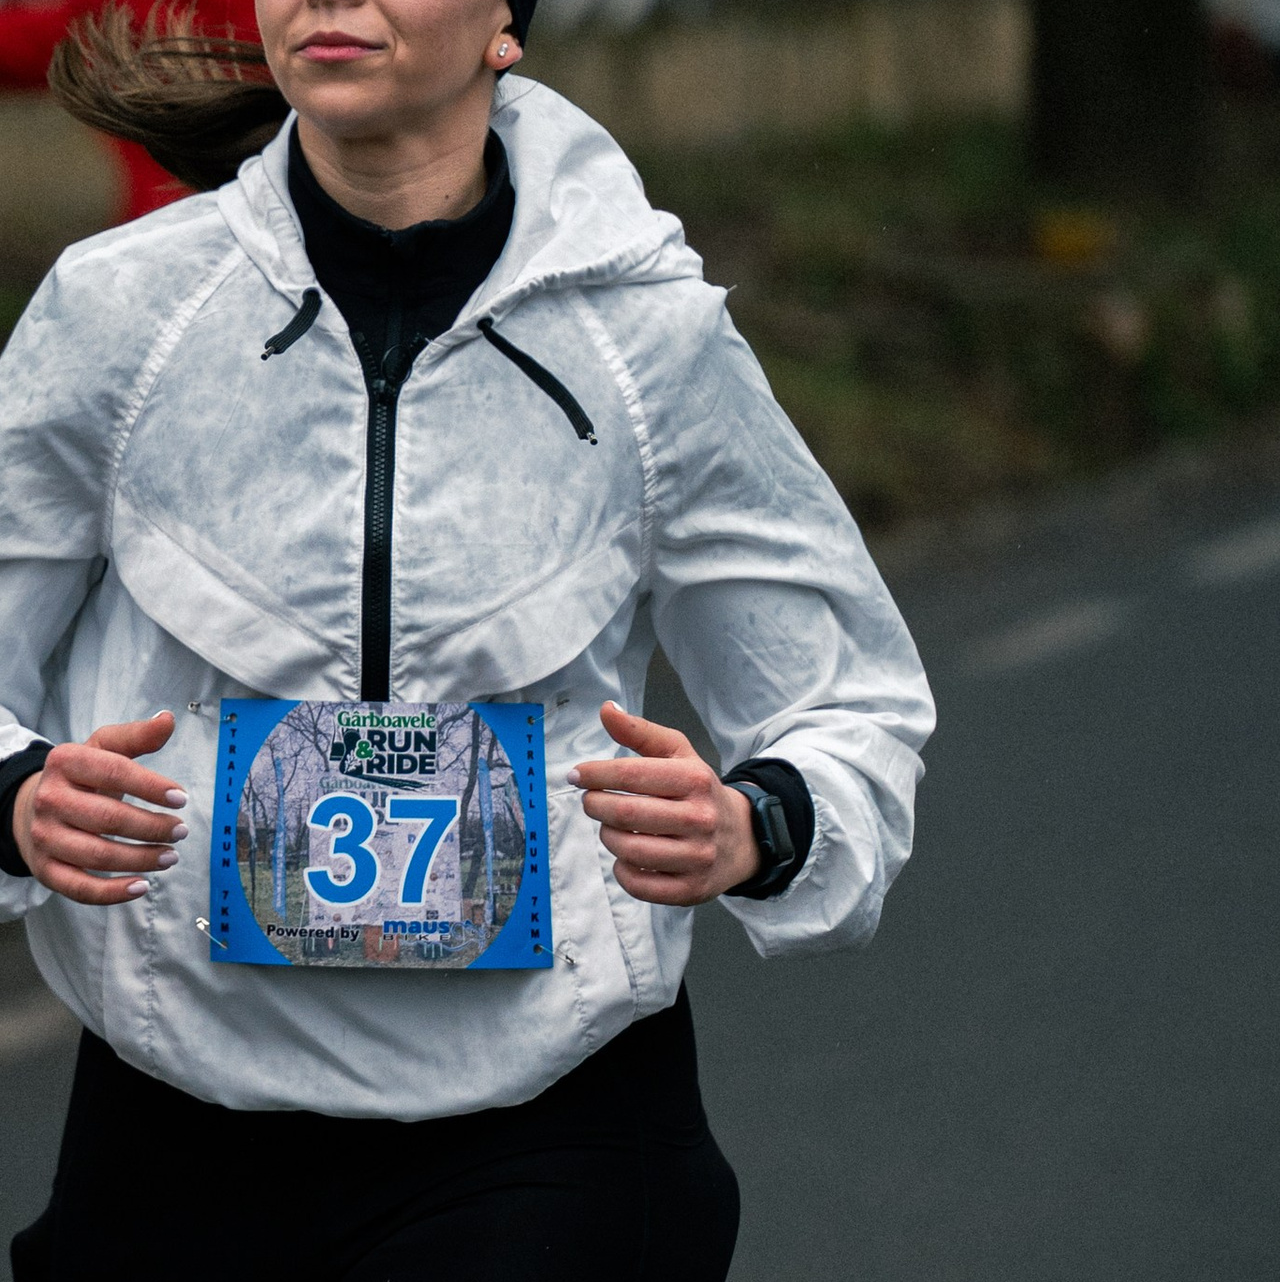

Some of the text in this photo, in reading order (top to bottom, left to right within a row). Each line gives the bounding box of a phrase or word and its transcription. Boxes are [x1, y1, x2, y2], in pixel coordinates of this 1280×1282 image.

[337, 709, 436, 728] Gârboavele
[355, 739, 374, 760] &
[367, 730, 436, 753] RUN
[366, 753, 436, 775] RIDE
[220, 728, 237, 933] TRAIL RUN 7KM
[526, 733, 540, 939] TRAIL RUN 7KM
[305, 794, 459, 905] 37
[267, 924, 359, 942] Powered by
[383, 919, 450, 934] maus
